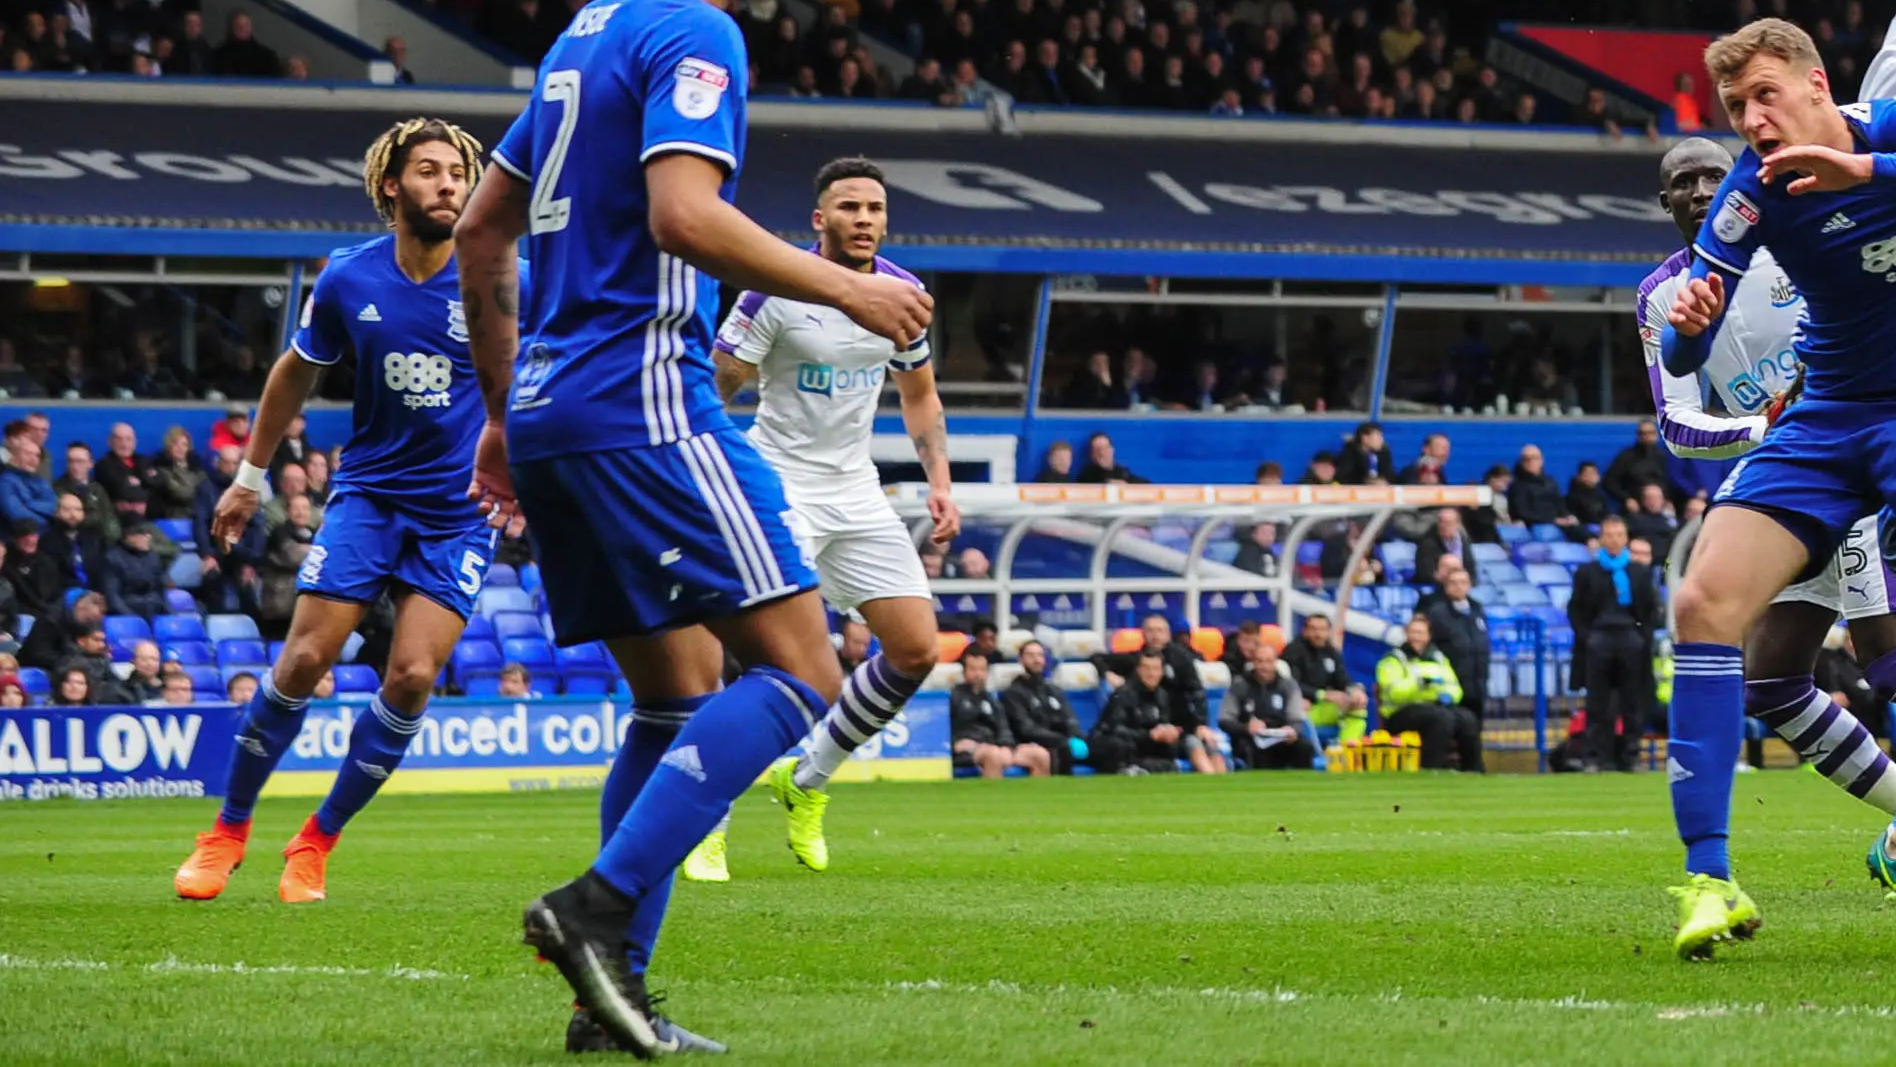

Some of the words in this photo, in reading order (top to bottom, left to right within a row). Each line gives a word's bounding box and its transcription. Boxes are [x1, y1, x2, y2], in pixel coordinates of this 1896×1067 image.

[0, 144, 368, 187] Grou
[529, 69, 581, 233] 2
[384, 352, 452, 393] 888
[403, 391, 451, 411] sport
[457, 550, 484, 595] 5
[0, 713, 202, 774] ALLOW
[294, 705, 529, 758] adnced
[543, 700, 633, 755] colo
[28, 778, 98, 801] drinks
[101, 775, 205, 799] solutions
